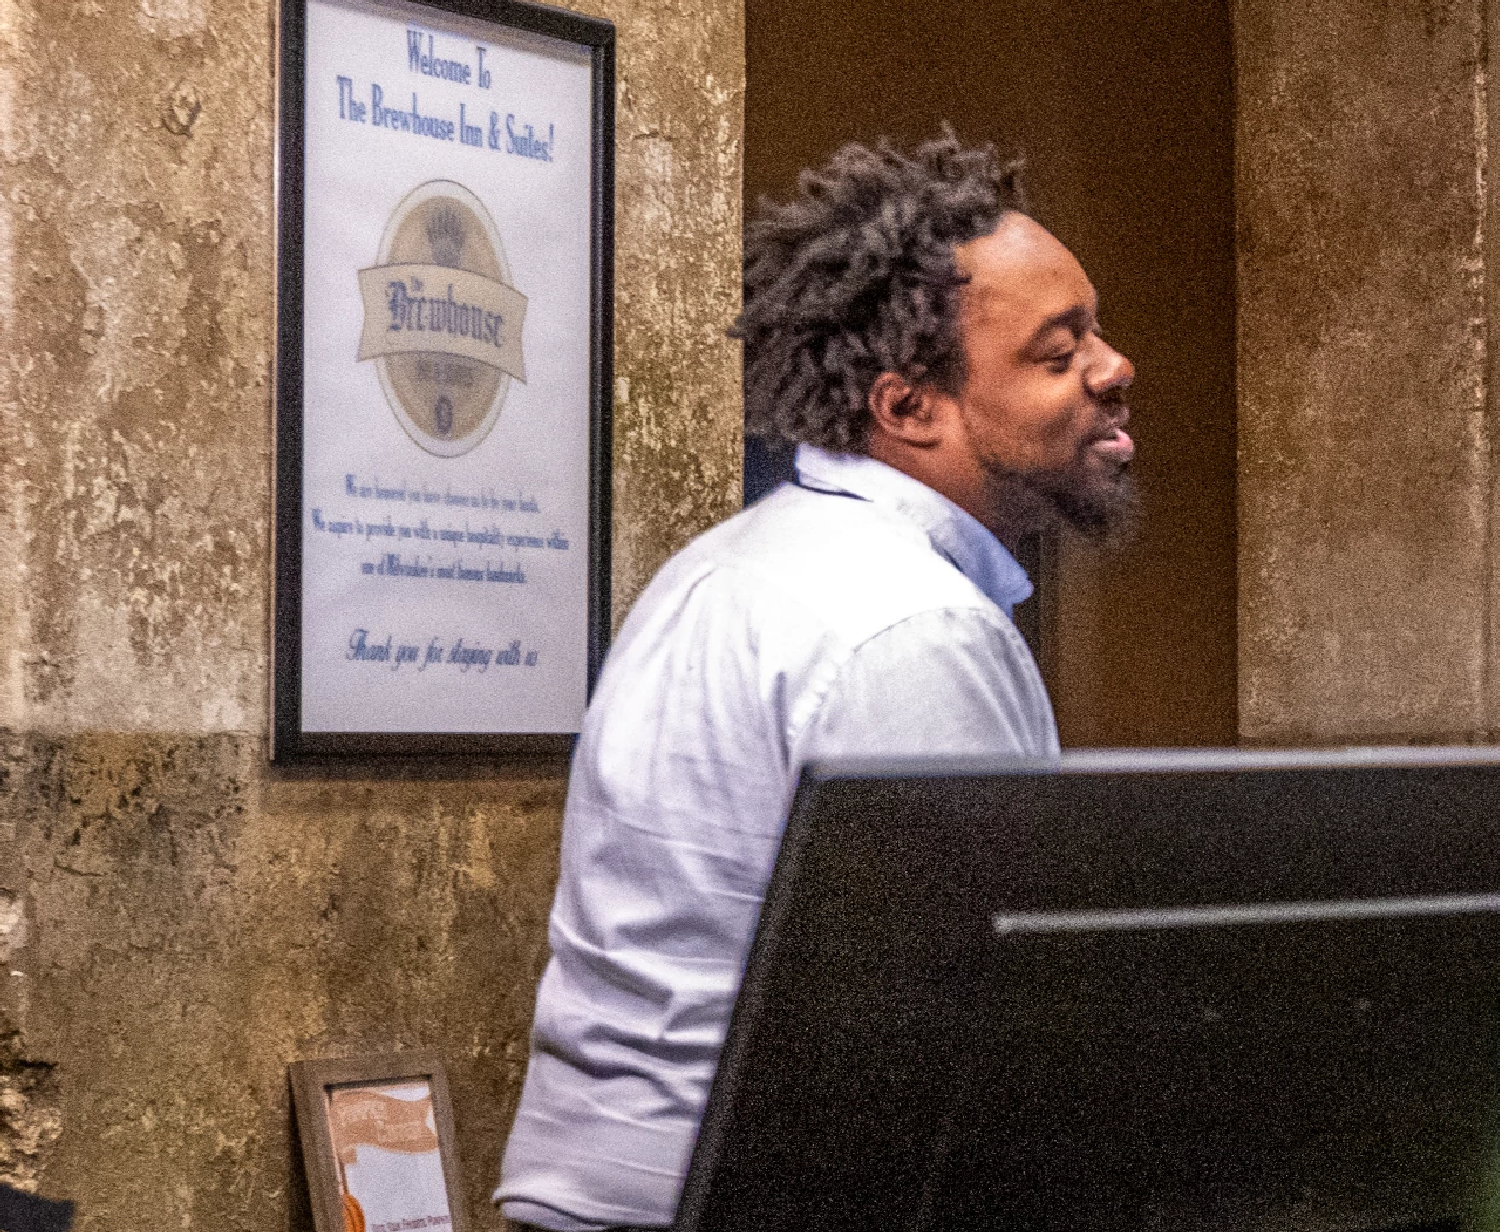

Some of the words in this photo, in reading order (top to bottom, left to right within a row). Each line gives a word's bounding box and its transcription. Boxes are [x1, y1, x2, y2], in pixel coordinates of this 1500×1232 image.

[406, 28, 472, 85] Welcome
[475, 46, 491, 89] To
[336, 74, 367, 124] The
[371, 83, 455, 142] Brewhouse
[460, 103, 483, 149] Inn
[488, 111, 502, 151] &
[506, 113, 554, 163] Suites!
[386, 280, 504, 347] Brewhouse
[346, 628, 392, 662] Thank
